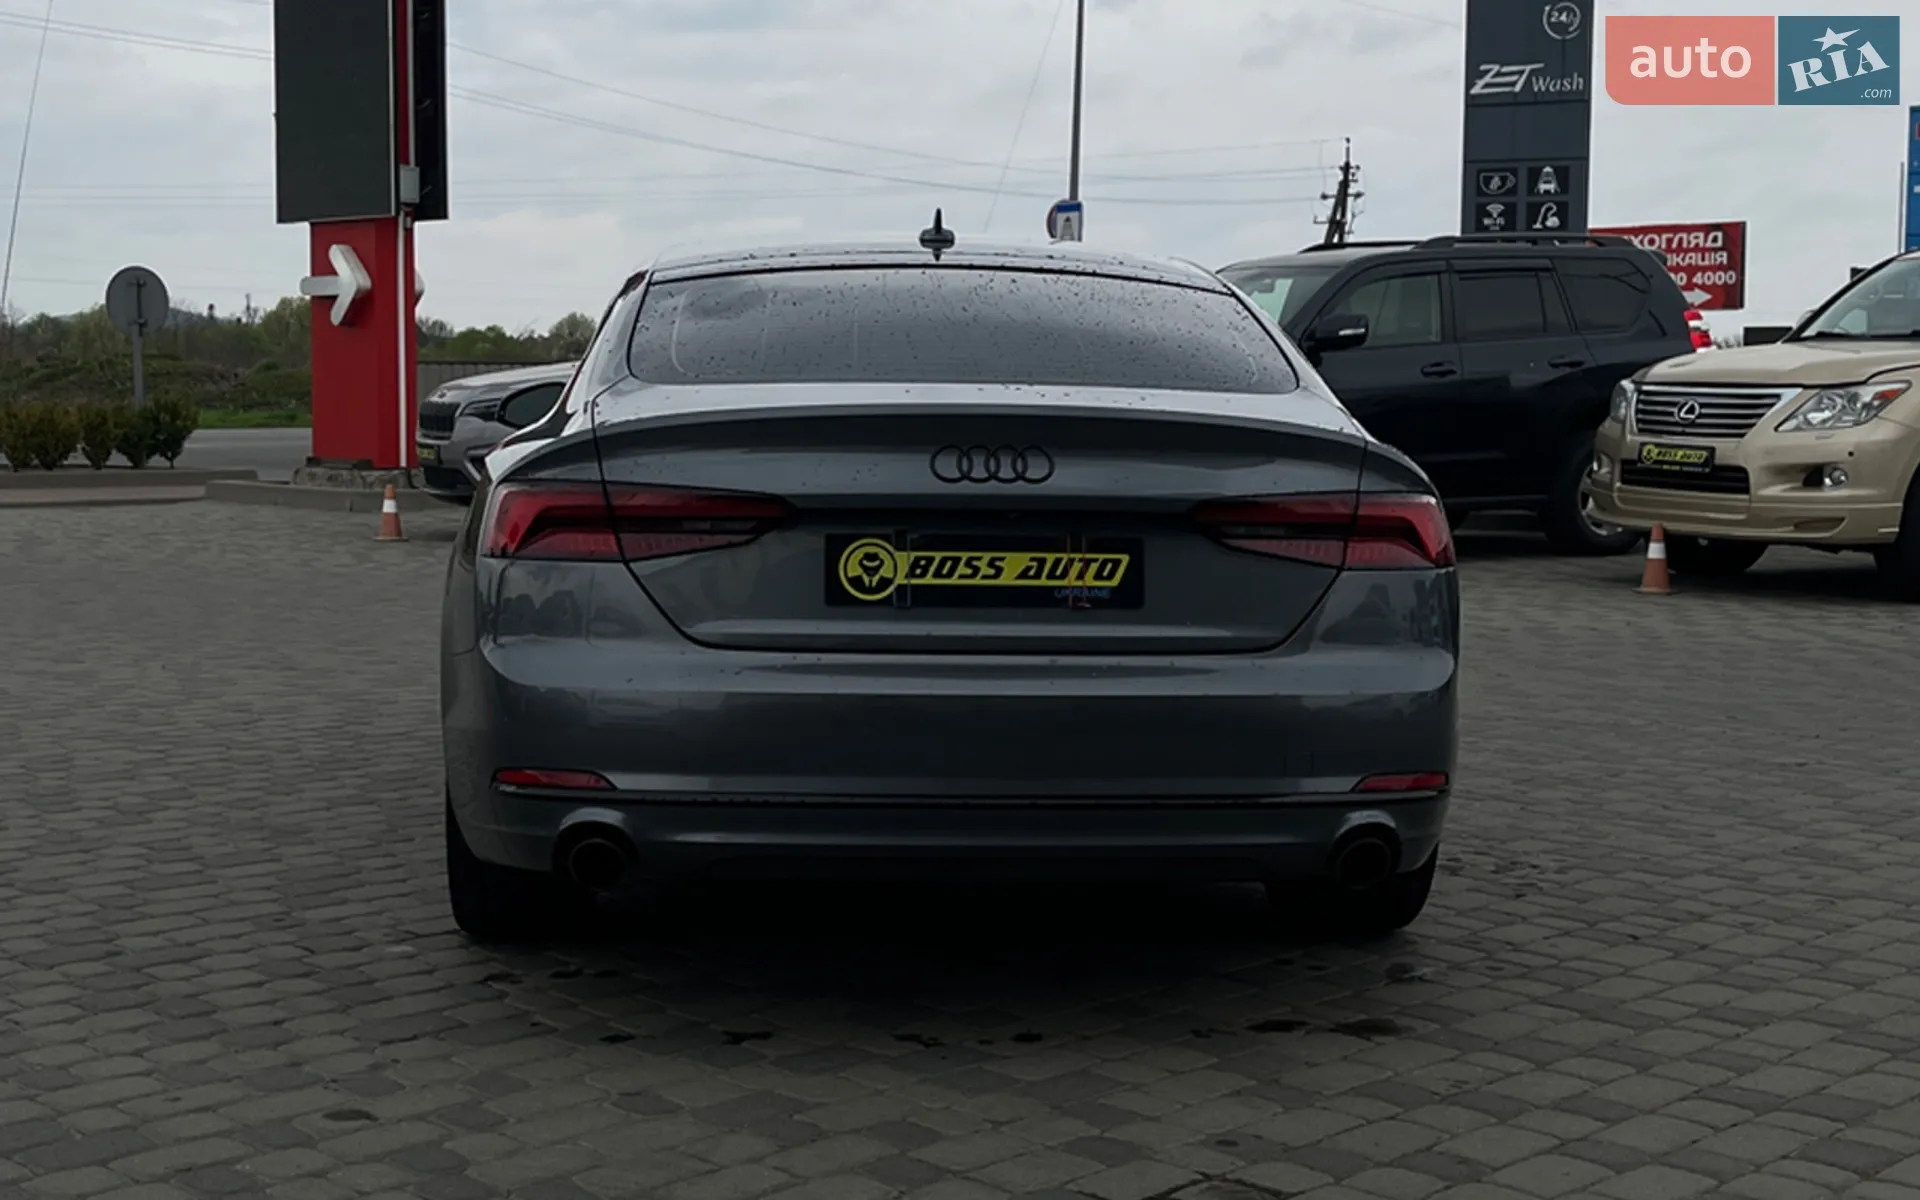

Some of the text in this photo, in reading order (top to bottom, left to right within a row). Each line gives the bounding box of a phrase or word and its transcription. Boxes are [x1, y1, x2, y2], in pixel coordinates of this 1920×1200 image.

[1469, 62, 1585, 95] ZET Wash
[1624, 230, 1724, 250] ХОГЛЯД
[1692, 271, 1737, 285] 4000
[904, 554, 1124, 582] BOSS AUTO
